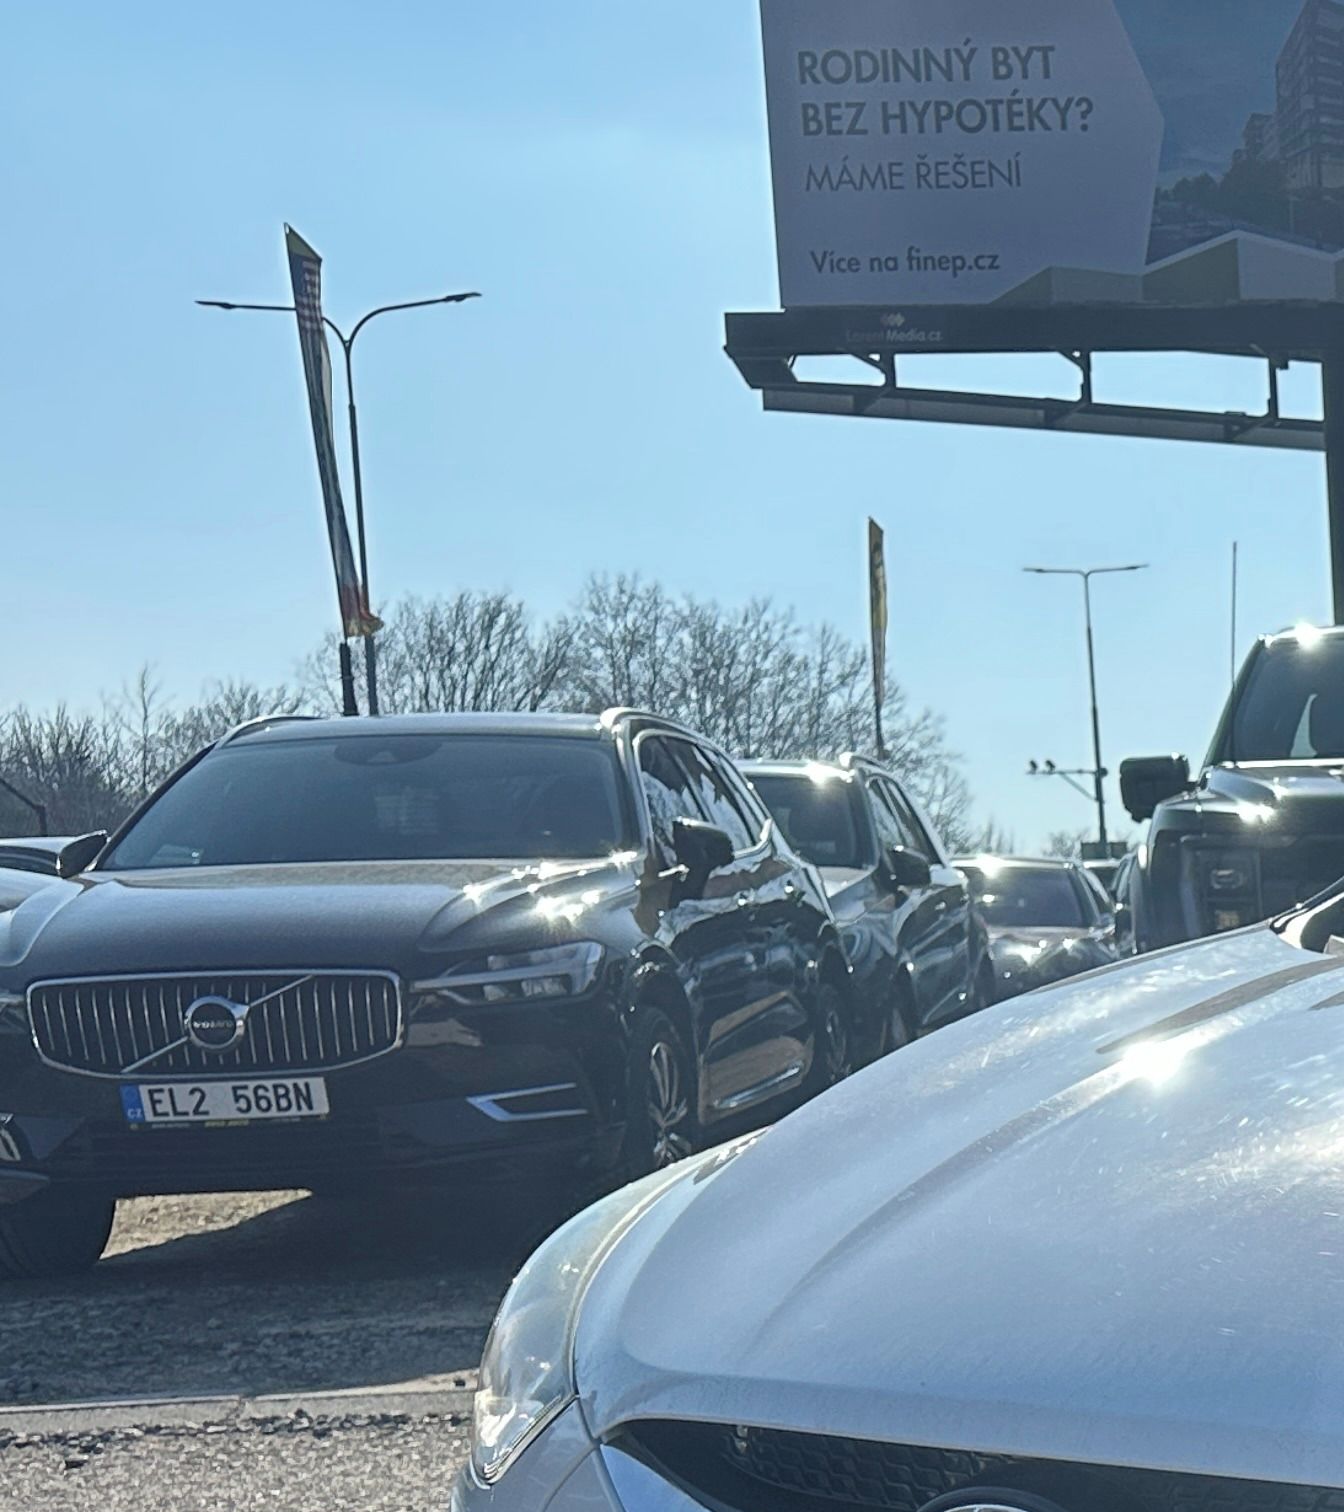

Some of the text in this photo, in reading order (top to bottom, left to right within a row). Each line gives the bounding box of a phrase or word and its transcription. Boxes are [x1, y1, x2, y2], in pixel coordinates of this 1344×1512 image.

[798, 38, 1056, 85] RODINNÝ BYT
[801, 88, 1094, 136] BEZ HYPOTÉKY?
[805, 152, 1022, 191] MÁME ŘEŠENÍ
[810, 246, 1000, 278] Více na finep.cz
[127, 1081, 314, 1119] CZ EL2 56BN
